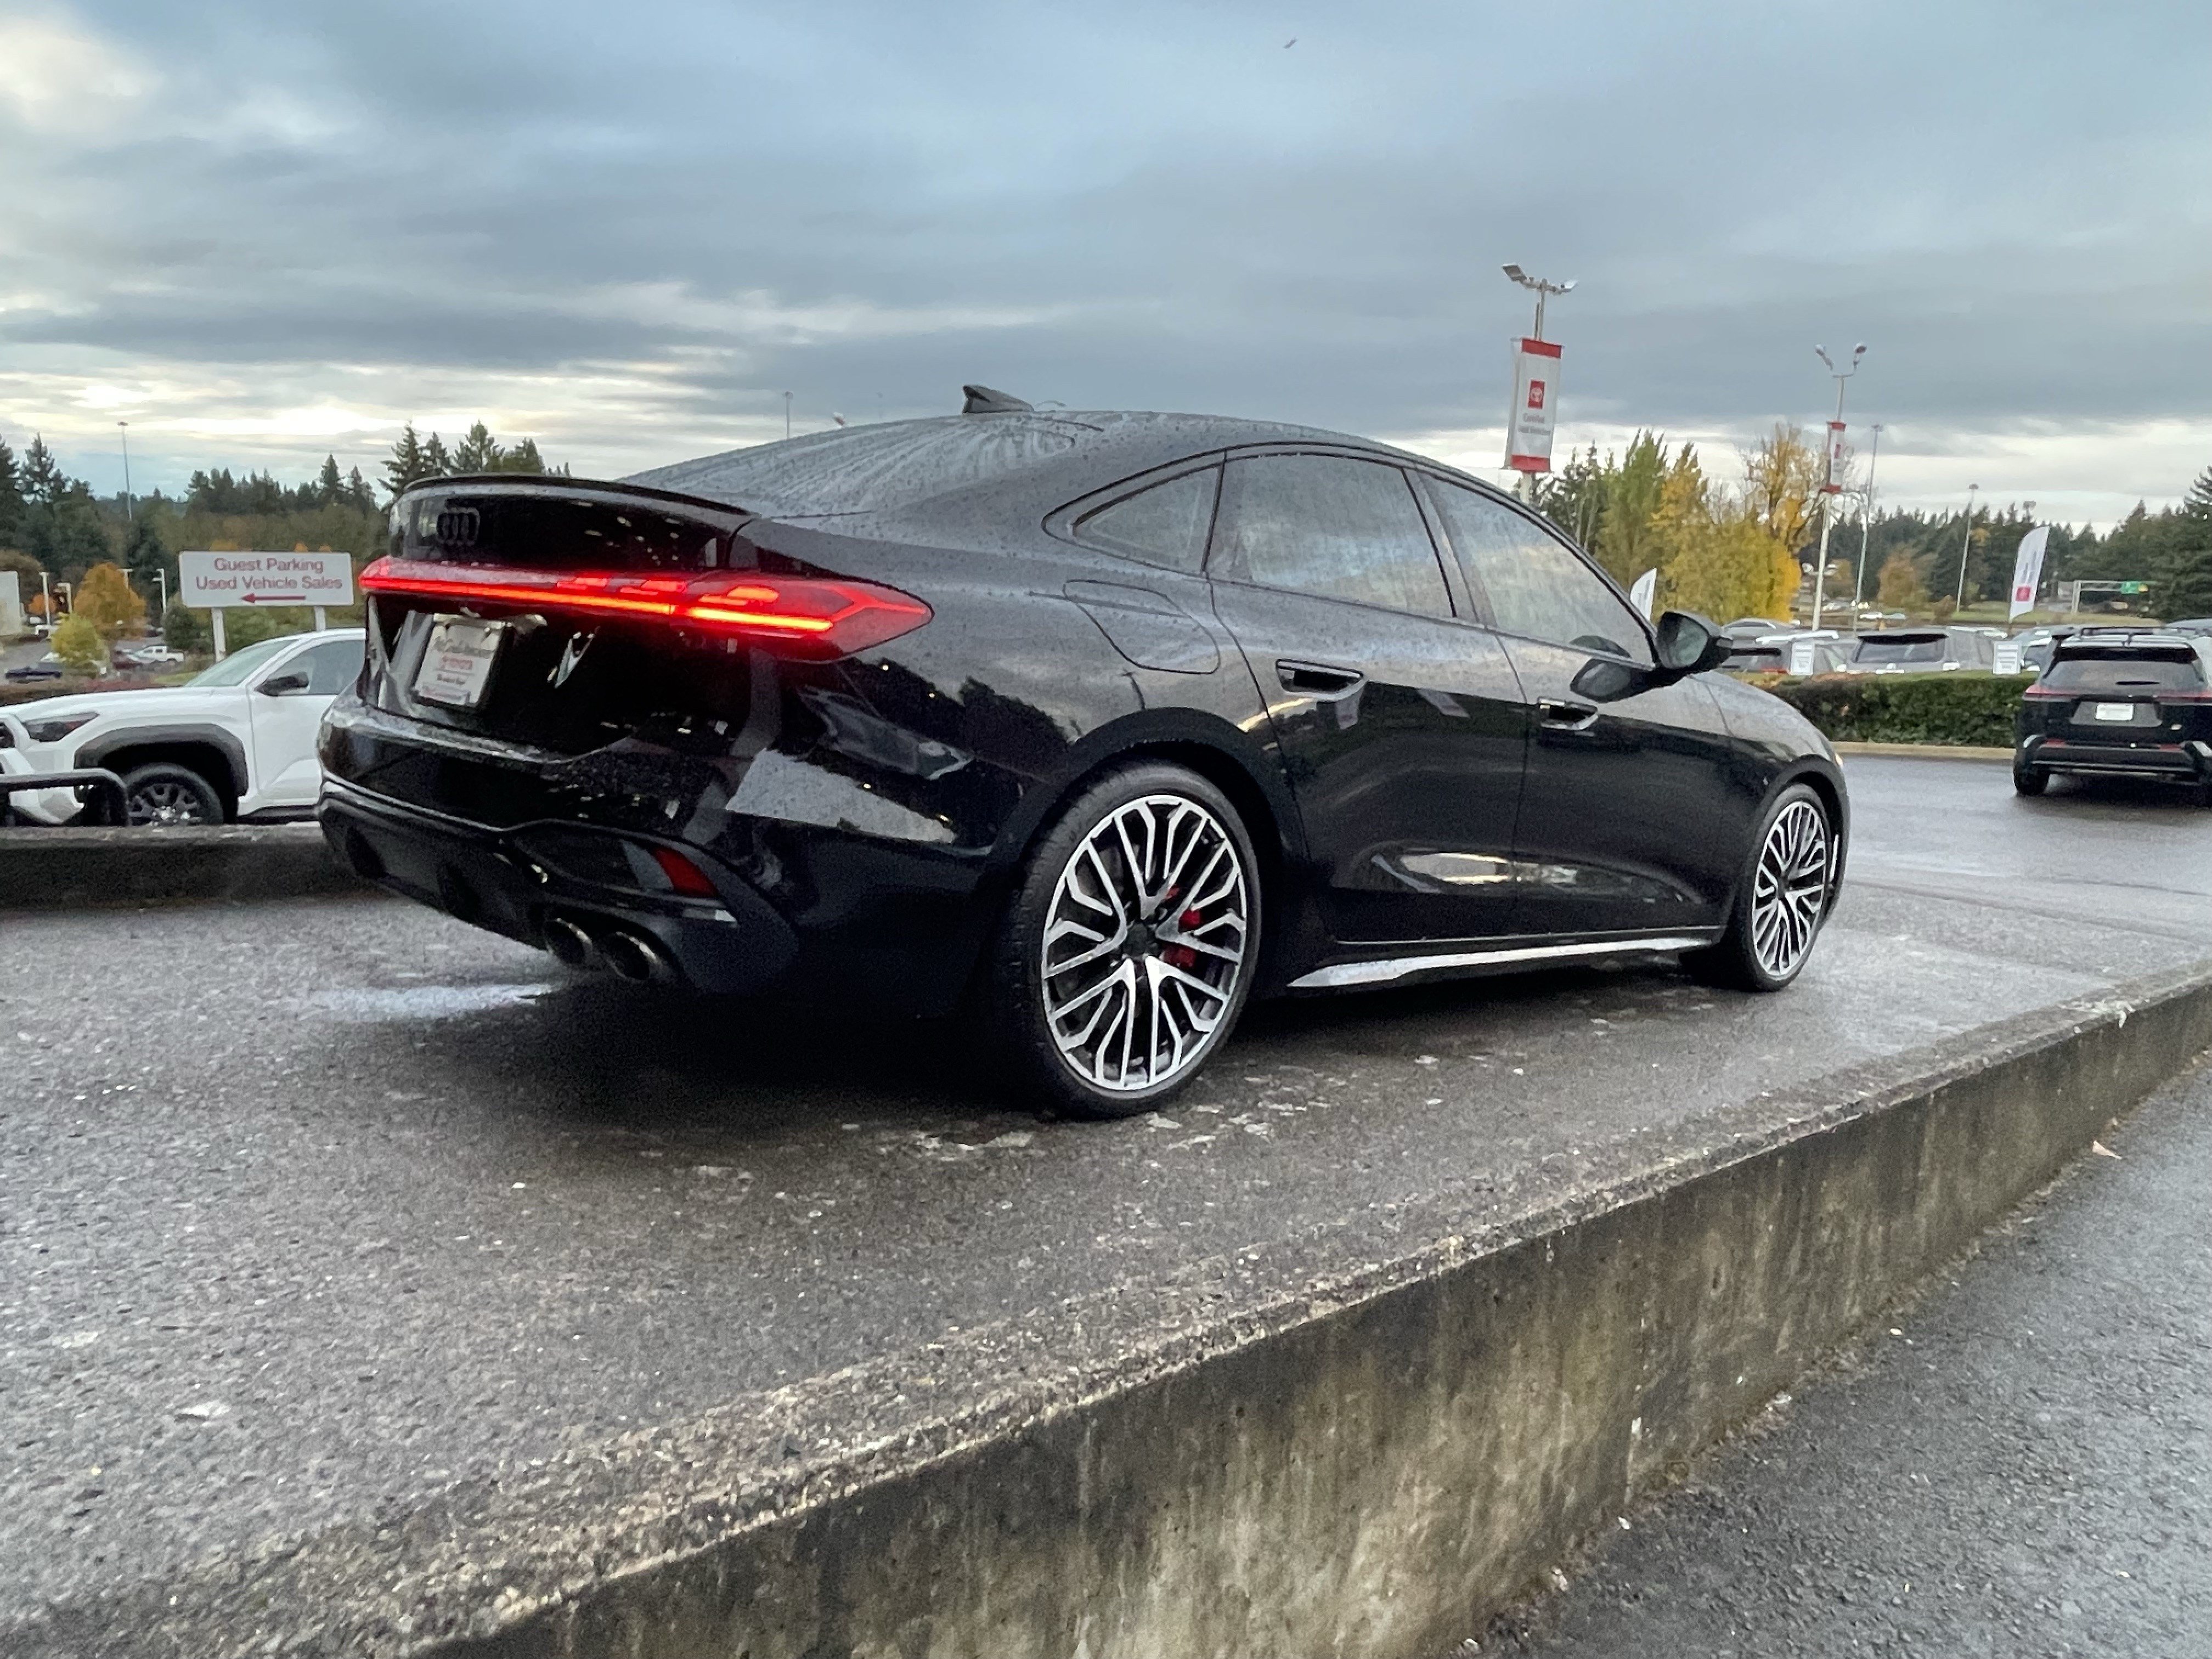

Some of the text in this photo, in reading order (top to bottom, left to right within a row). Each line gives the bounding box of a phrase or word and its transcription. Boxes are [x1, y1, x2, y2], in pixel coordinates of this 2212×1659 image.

[214, 557, 324, 574] Guest Parking
[195, 575, 342, 590] Used Vehicle Sales
